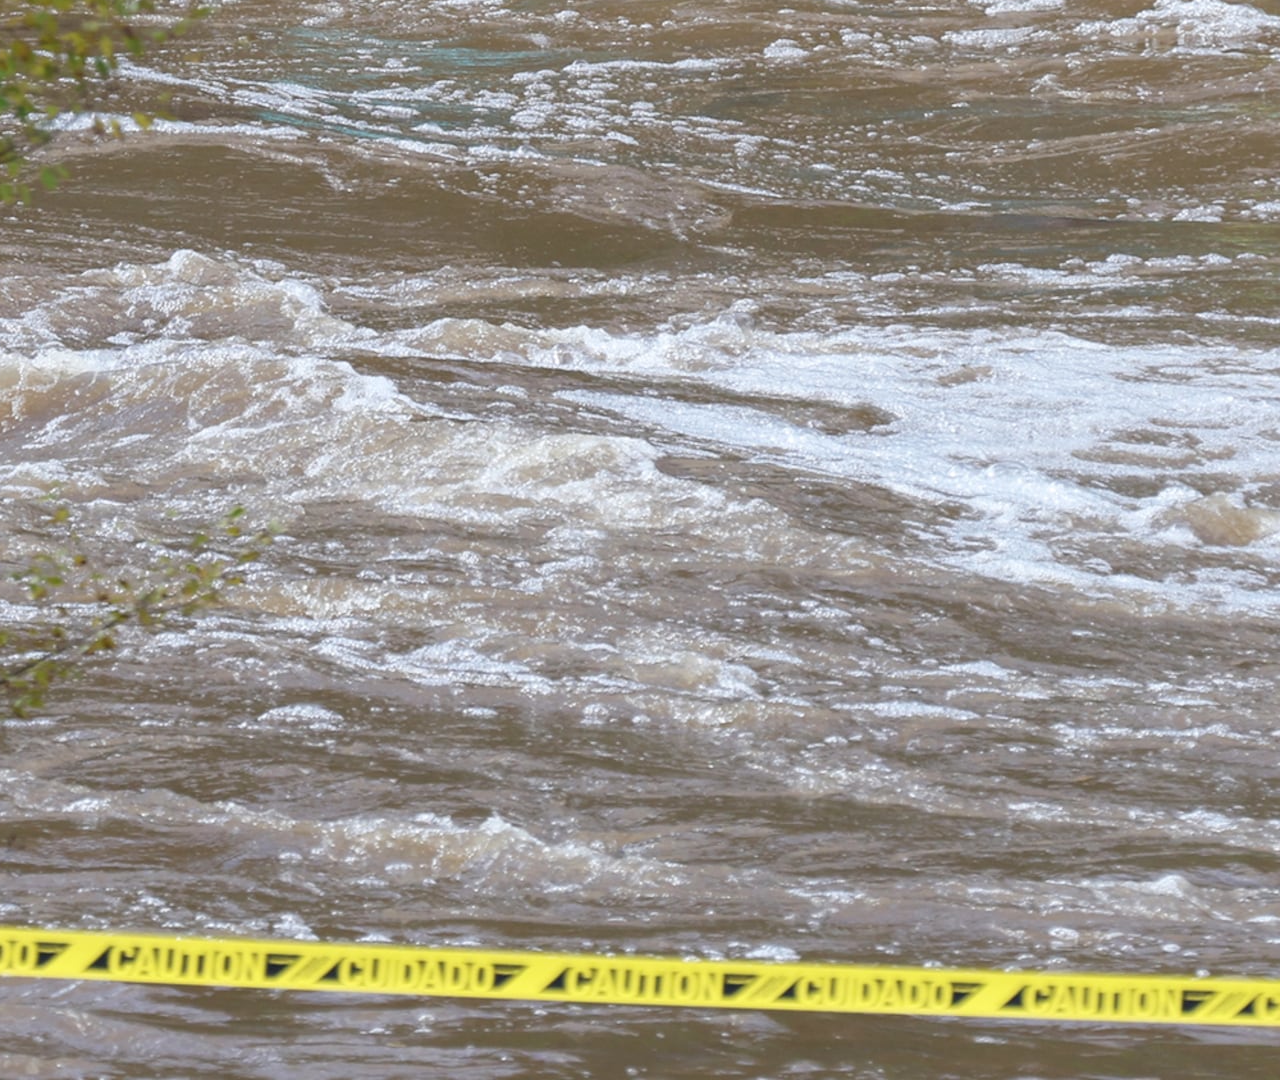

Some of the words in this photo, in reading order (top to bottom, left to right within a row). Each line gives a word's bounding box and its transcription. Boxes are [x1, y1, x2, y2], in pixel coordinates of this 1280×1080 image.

[109, 945, 267, 980] CAUTION
[339, 957, 495, 991] CUIDADO
[565, 967, 724, 1001] CAUTION
[797, 978, 952, 1008] CUIDADO
[1023, 985, 1182, 1017] CAUTION
